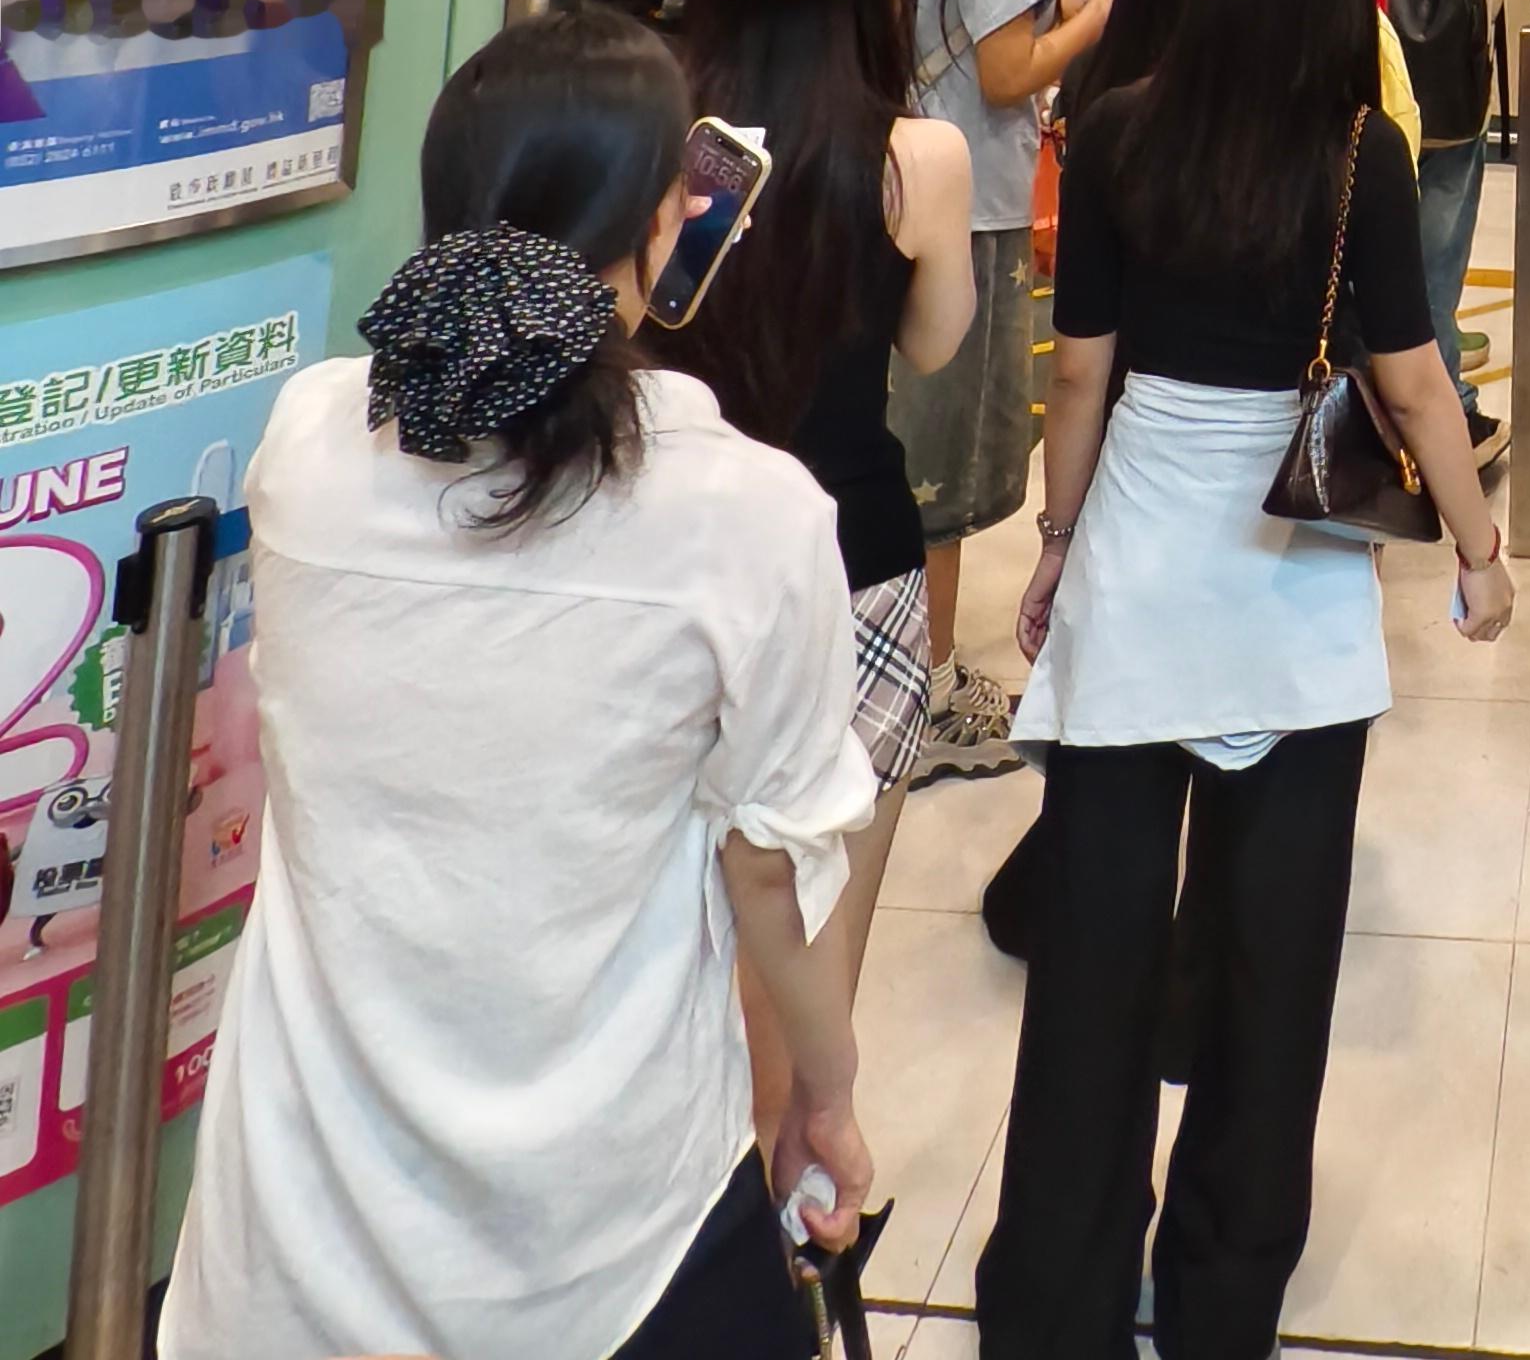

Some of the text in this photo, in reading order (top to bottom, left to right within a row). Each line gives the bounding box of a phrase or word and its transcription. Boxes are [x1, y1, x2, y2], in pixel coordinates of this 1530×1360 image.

[95, 393, 167, 422] Update
[173, 384, 194, 401] of
[200, 354, 296, 394] Particulars
